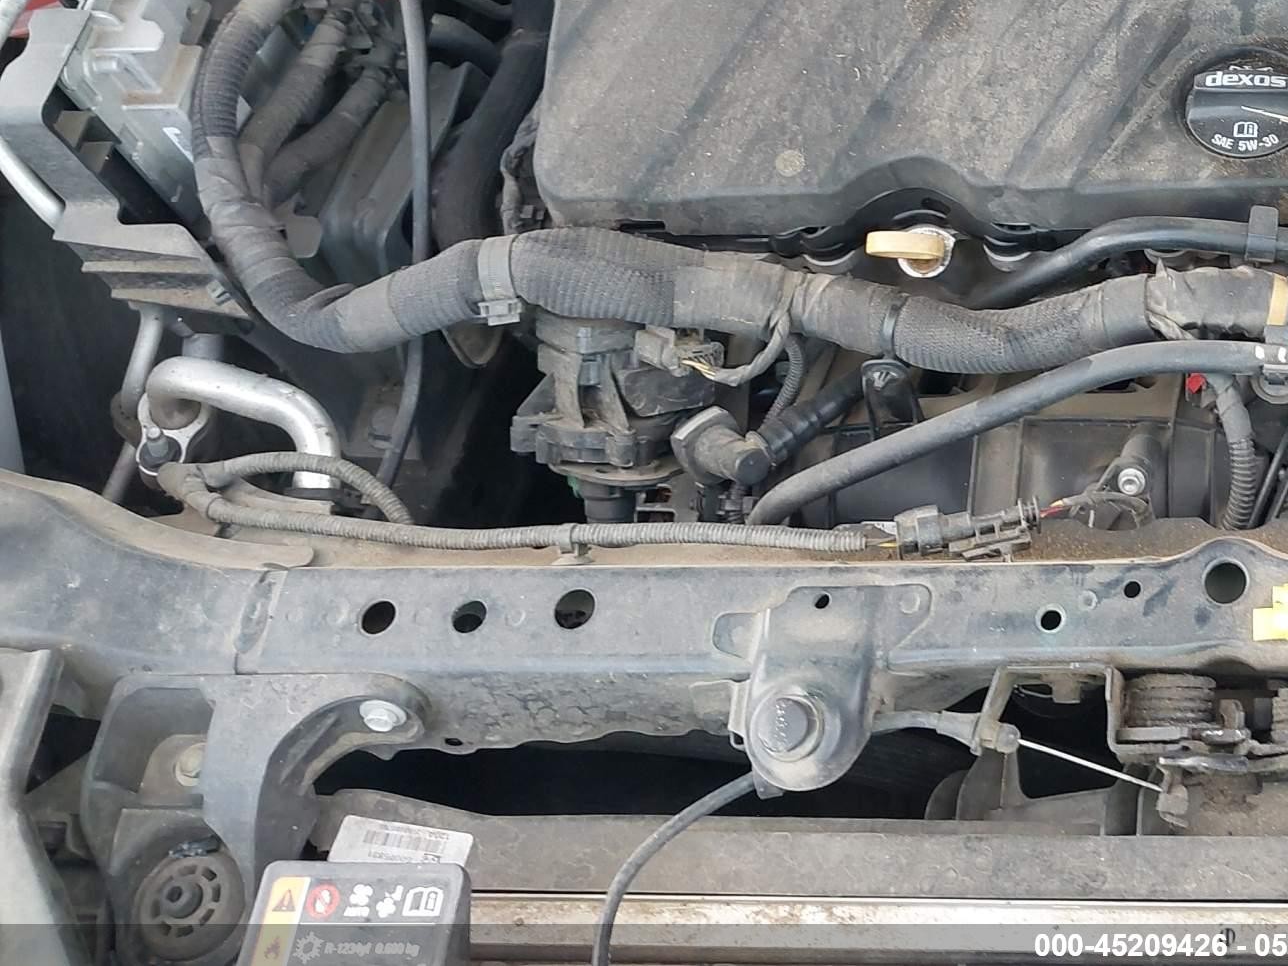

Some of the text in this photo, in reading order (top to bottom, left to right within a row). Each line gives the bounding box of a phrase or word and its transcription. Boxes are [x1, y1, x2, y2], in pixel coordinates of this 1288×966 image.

[1205, 71, 1288, 88] dexos
[1211, 133, 1280, 152] SAE 5W-30
